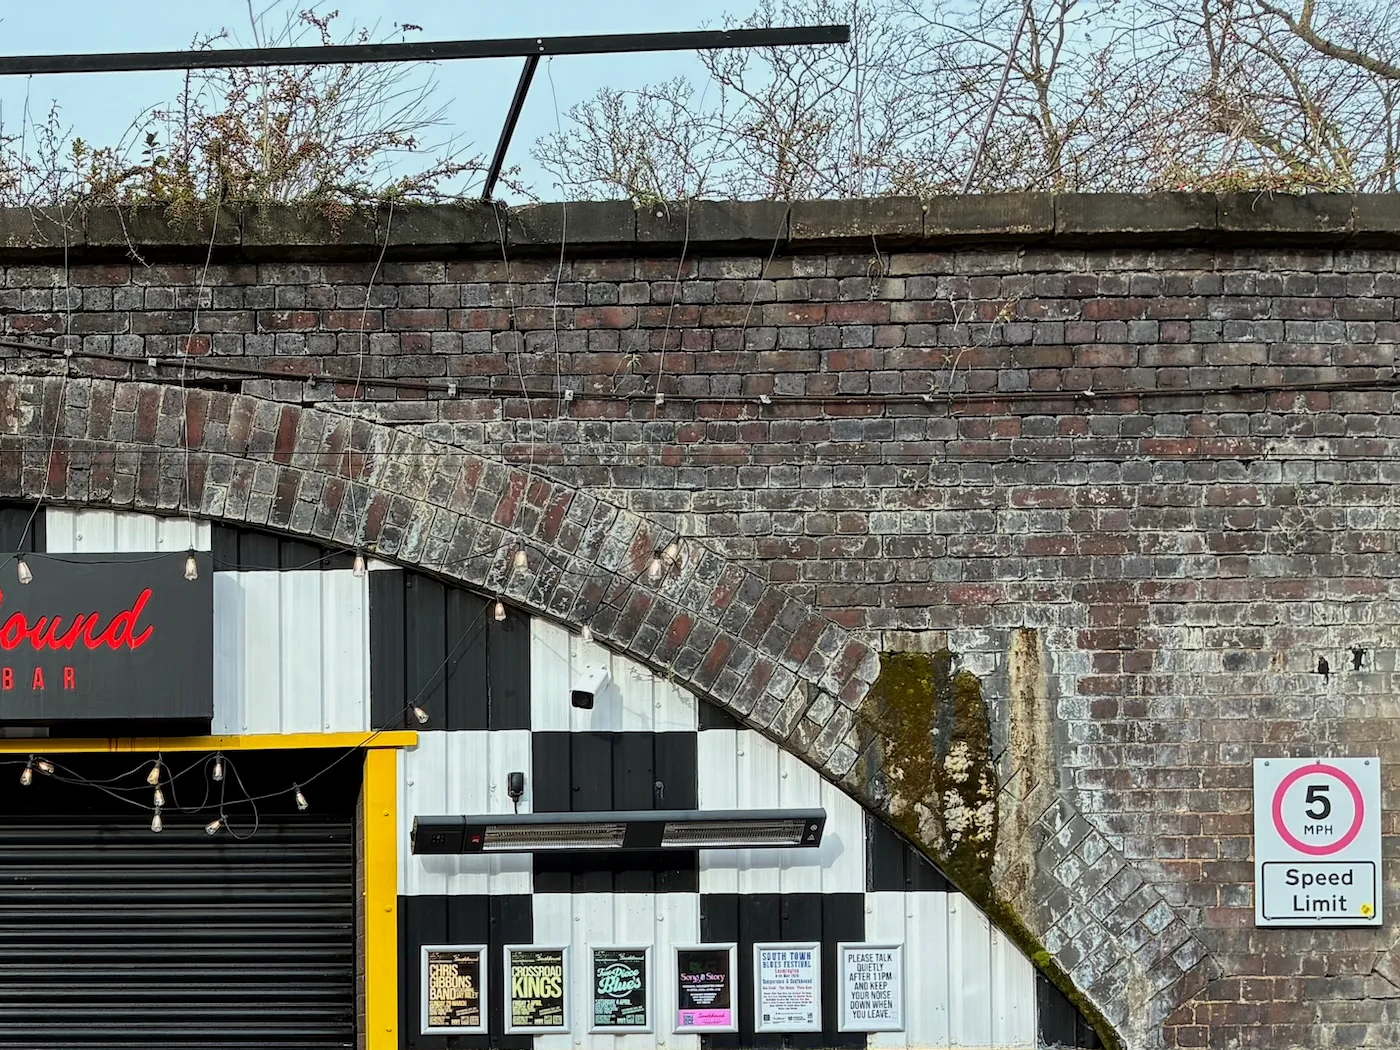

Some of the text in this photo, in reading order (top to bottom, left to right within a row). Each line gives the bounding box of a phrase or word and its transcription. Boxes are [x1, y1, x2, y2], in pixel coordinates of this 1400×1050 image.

[1305, 785, 1331, 820] 5
[1304, 825, 1333, 835] MPH
[1285, 868, 1353, 888] Speed
[1294, 894, 1348, 912] Limit
[762, 952, 811, 960] SOUTH TOWN
[848, 954, 892, 962] PLEASE TALK
[430, 964, 458, 976] CHRIS
[512, 966, 561, 977] CROSSROAD
[857, 963, 884, 971] QUIETLY
[430, 976, 472, 988] GIBBONS
[706, 972, 725, 983] Story
[849, 972, 892, 981] AFTER 11PM
[512, 976, 562, 998] KINGS
[598, 976, 641, 994] Blue's
[854, 982, 887, 990] AND KEEP
[430, 988, 456, 1000] BAND
[851, 991, 891, 1000] YOUR NOISE
[850, 1000, 892, 1009] DOWN WHEN
[853, 1010, 891, 1019] YOU LEAVE.
